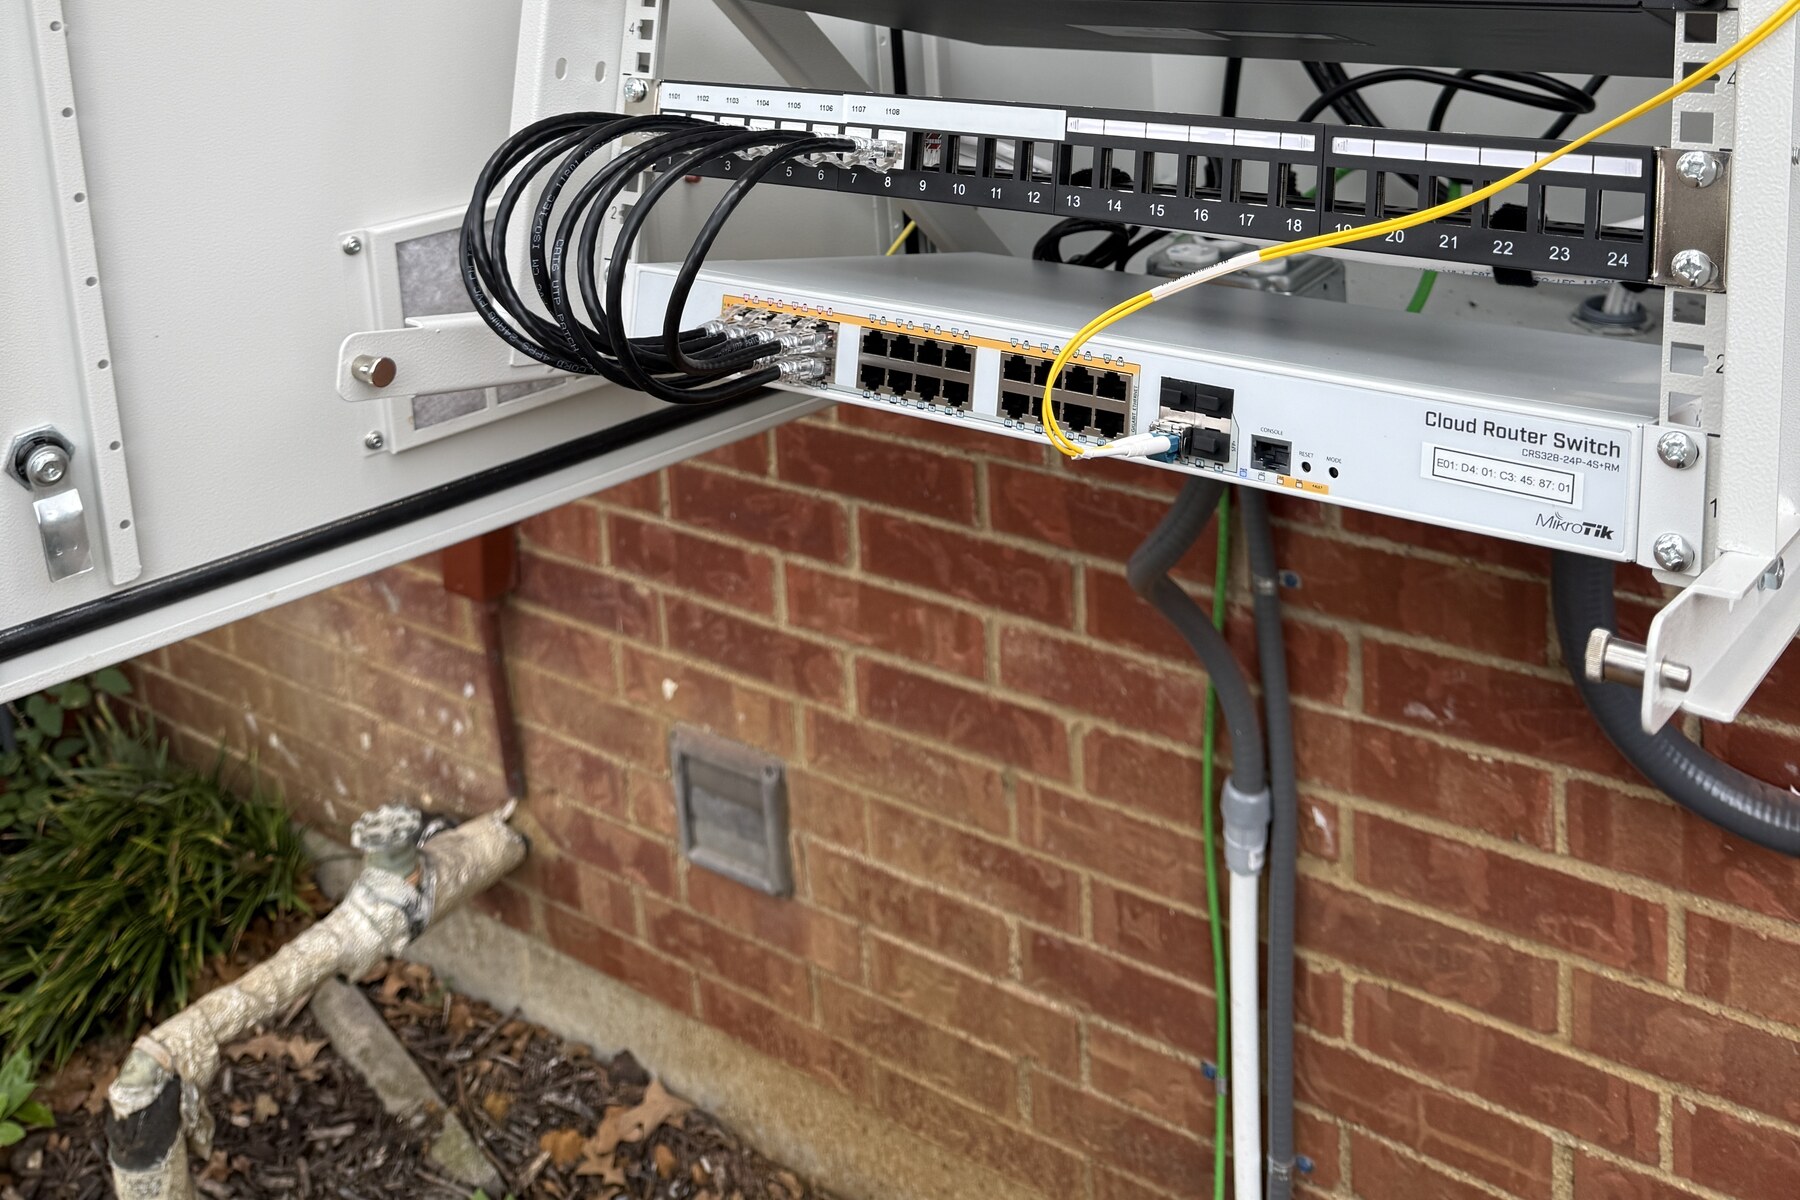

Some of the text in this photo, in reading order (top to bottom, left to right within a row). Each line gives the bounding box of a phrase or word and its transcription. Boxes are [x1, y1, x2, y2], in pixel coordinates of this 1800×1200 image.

[668, 92, 901, 116] 1101 1102 1103 1104 1105 1106 1107 1108
[531, 194, 556, 250] ISO/IEC
[610, 205, 618, 220] 2
[724, 160, 731, 171] 3
[785, 166, 793, 177] 5
[817, 169, 825, 181] 6
[851, 172, 858, 184] 7
[884, 176, 892, 188] 8
[919, 179, 927, 192] 9
[952, 183, 966, 196] 10
[990, 187, 1002, 200] 11
[1027, 191, 1041, 204] 12
[1066, 194, 1081, 208] 13
[1107, 199, 1122, 212] 14
[1149, 203, 1165, 217] 15
[1193, 208, 1209, 222] 16
[1239, 213, 1255, 227] 17
[1286, 218, 1302, 233] 18
[1384, 229, 1405, 243] 20
[1439, 234, 1458, 249] 21
[1492, 239, 1514, 256] 22
[1548, 245, 1571, 262] 23
[1607, 251, 1629, 268] 24
[531, 259, 540, 276] CM
[551, 279, 561, 306] UTP
[557, 313, 580, 353] PATCH
[1715, 353, 1724, 374] 2
[1260, 426, 1284, 436] CONSOLE
[1425, 411, 1621, 458] Cloud Router Switch
[1298, 450, 1314, 459] RESET
[1325, 456, 1342, 464] MODE
[1521, 448, 1620, 472] CRS328-24P-4S+RM
[1461, 463, 1479, 475] D4:
[1481, 467, 1497, 479] 01:
[1499, 471, 1517, 482] C3:
[1519, 475, 1535, 486] 45:
[1538, 479, 1555, 490] 87:
[1557, 482, 1570, 493] 01
[1709, 497, 1718, 518] 1
[1535, 512, 1615, 540] MikroTik
